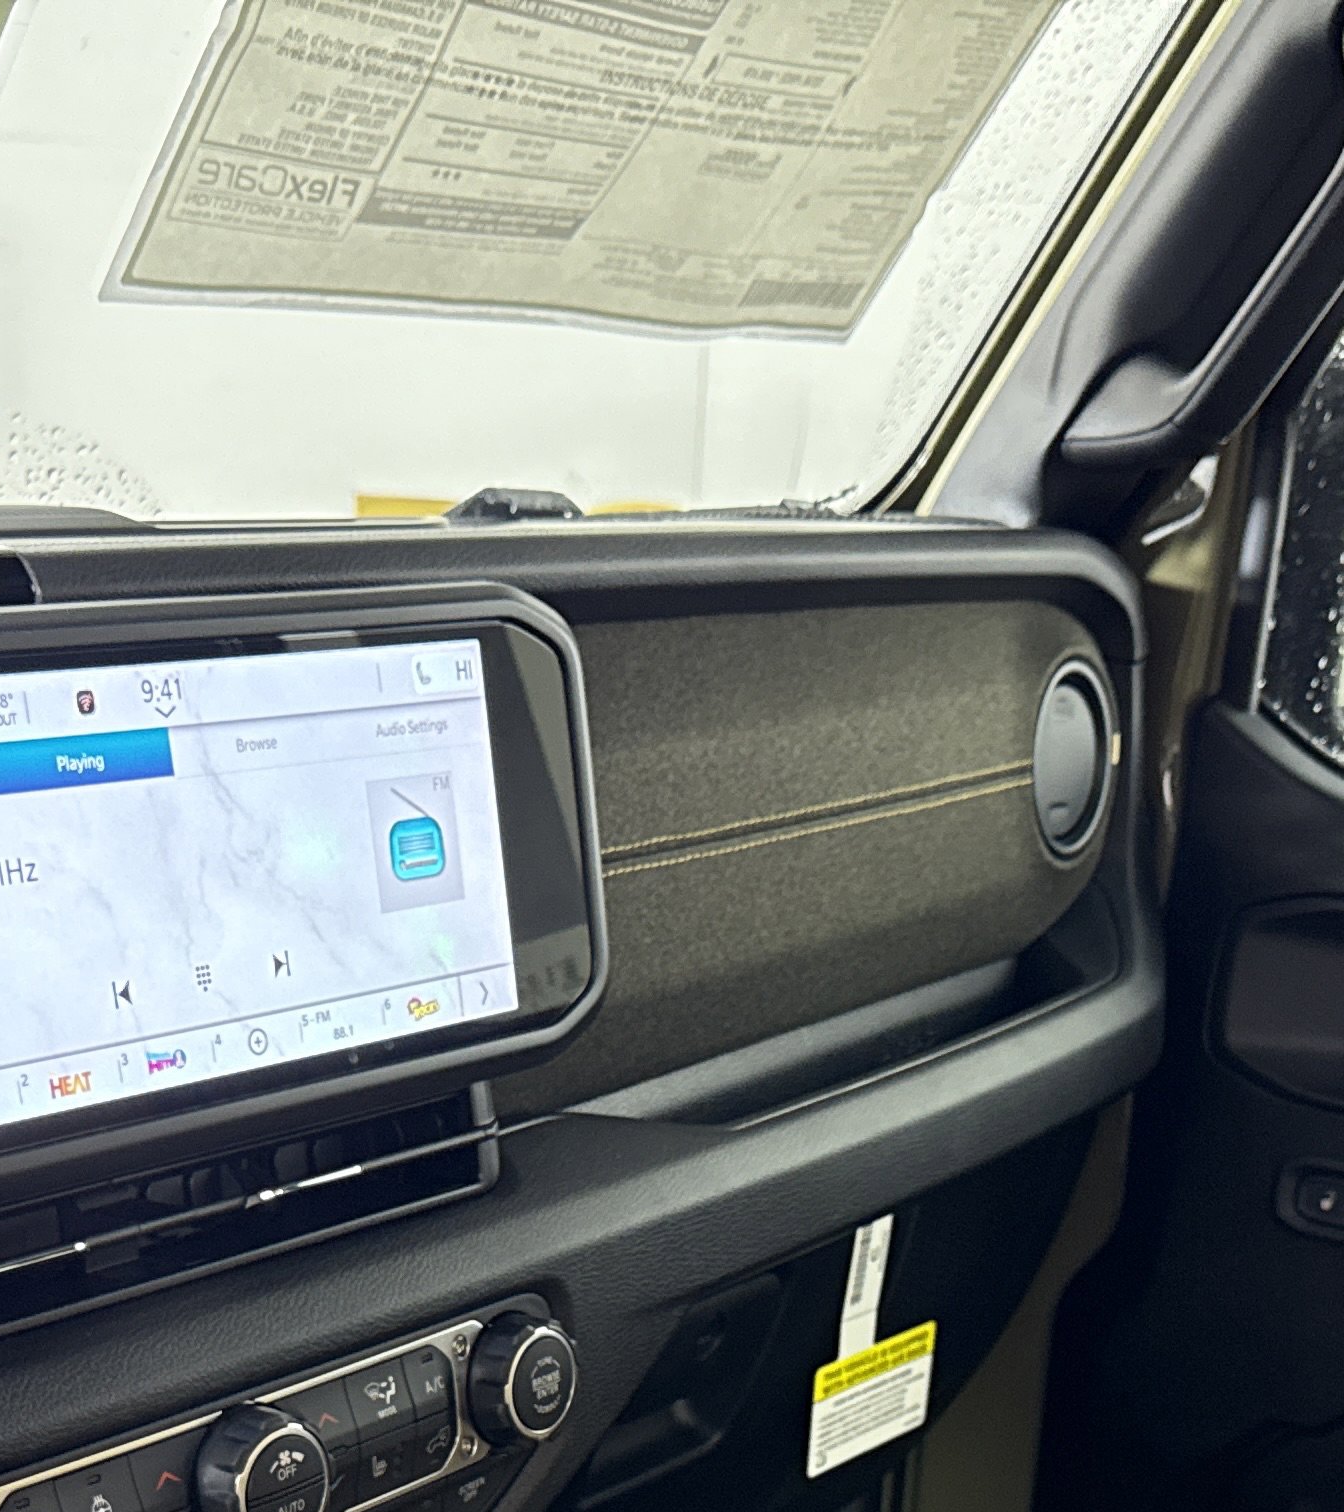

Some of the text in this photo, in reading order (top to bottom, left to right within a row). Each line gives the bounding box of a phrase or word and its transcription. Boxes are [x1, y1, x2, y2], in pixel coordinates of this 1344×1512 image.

[456, 659, 473, 681] HI
[141, 677, 182, 703] 9:41
[376, 719, 449, 738] Audio Settings
[236, 736, 278, 753] Browse
[56, 753, 105, 775] Playing
[433, 775, 451, 791] FM
[21, 1074, 29, 1087] 2
[49, 1071, 92, 1099] HEAT
[425, 1374, 445, 1395] A/C
[377, 1405, 398, 1419] MODE
[277, 1463, 298, 1482] OFF
